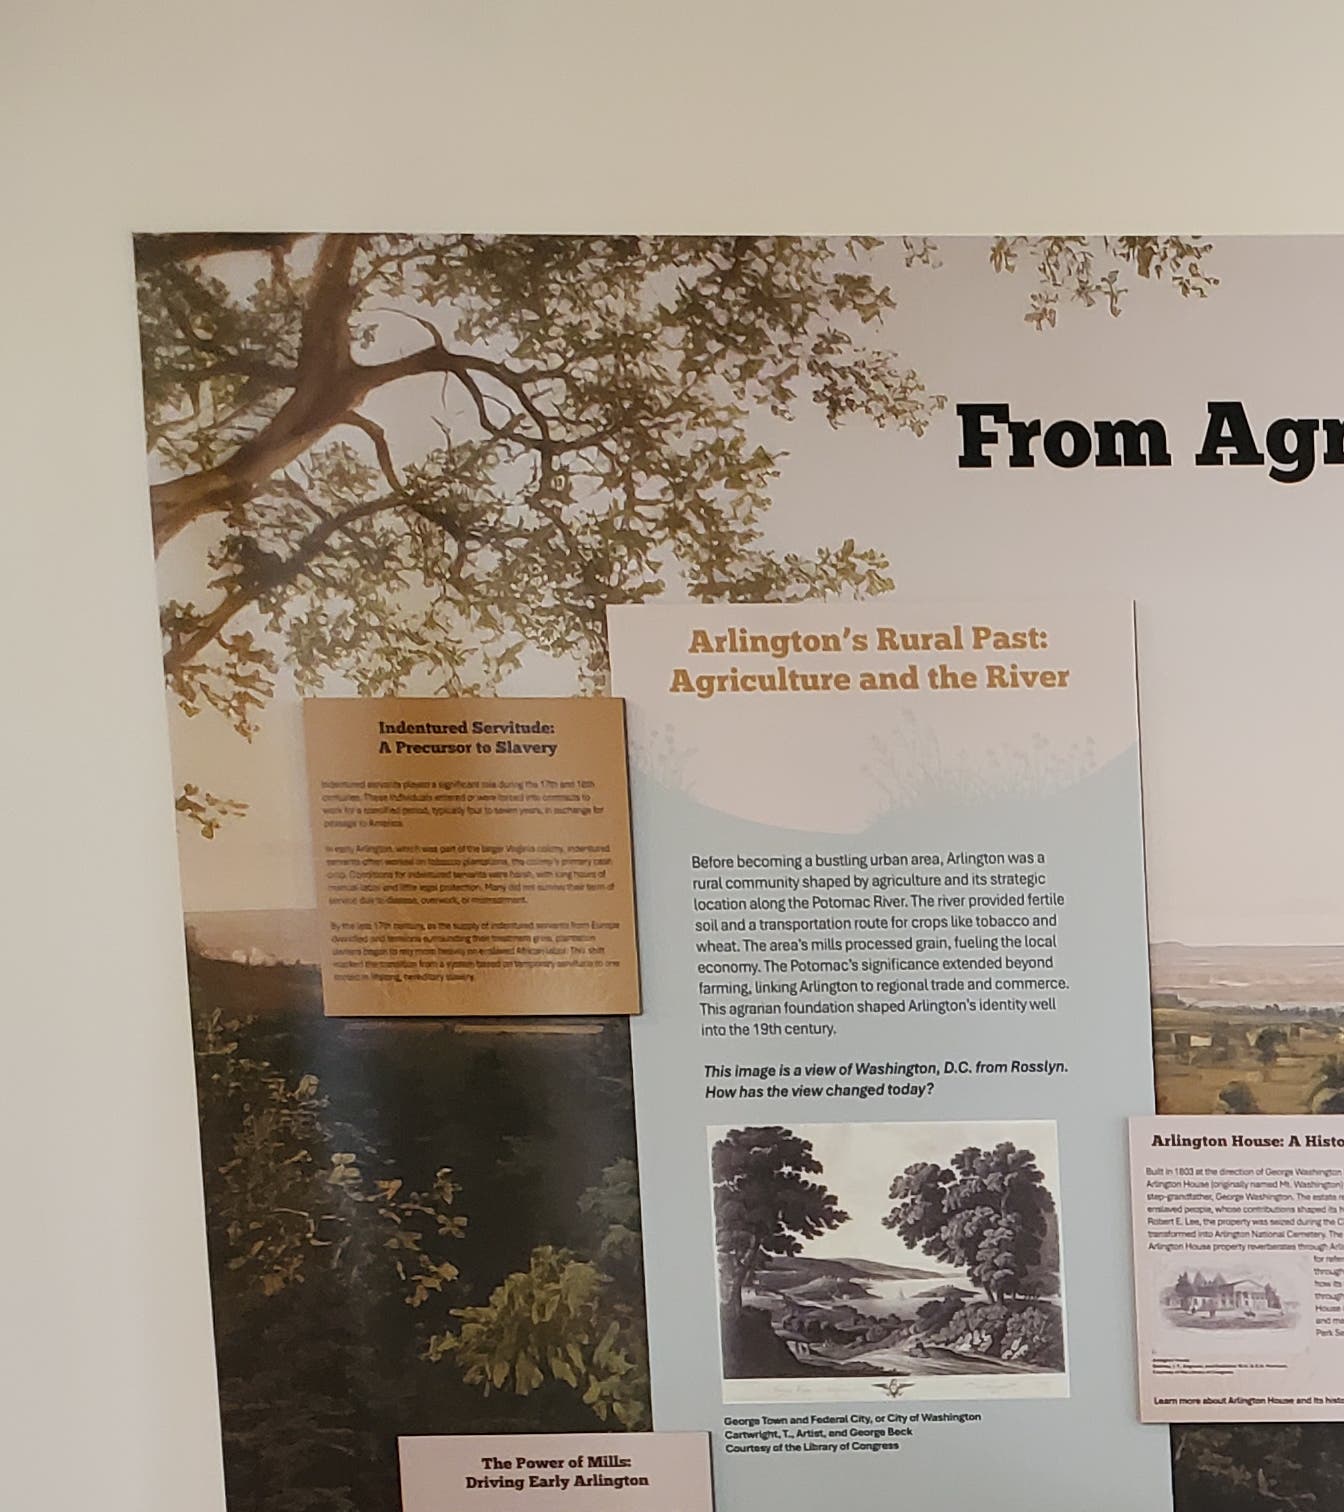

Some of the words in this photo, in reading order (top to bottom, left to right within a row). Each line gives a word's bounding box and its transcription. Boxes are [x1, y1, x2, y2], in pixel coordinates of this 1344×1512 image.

[956, 403, 1171, 467] From
[688, 628, 867, 658] Arlington's
[876, 625, 963, 650] Rural
[972, 626, 1047, 649] Past:
[669, 667, 850, 698] Agriculture
[859, 665, 919, 690] and
[927, 664, 976, 689] the
[985, 664, 1069, 688] River
[379, 720, 468, 734] Indentured
[472, 720, 554, 734] Servitude:
[379, 741, 391, 753] A
[395, 741, 471, 753] Precursor
[475, 742, 491, 753] to
[495, 740, 557, 756] Slavery
[704, 1065, 731, 1077] This
[735, 1065, 775, 1079] image
[779, 1064, 790, 1076] is
[793, 1066, 801, 1076] a
[804, 1064, 836, 1076] view
[839, 1063, 853, 1075] of
[855, 1062, 940, 1077] Washington,
[975, 1061, 1007, 1073] from
[1010, 1060, 1068, 1075] Rosslyn.
[1151, 1134, 1227, 1149] Arlington
[1231, 1135, 1283, 1147] House:
[1288, 1135, 1301, 1147] A
[724, 1417, 760, 1427] George
[761, 1416, 787, 1424] Town
[790, 1416, 809, 1424] and
[810, 1415, 848, 1423] Federal
[887, 1413, 907, 1424] City
[909, 1413, 919, 1422] of
[921, 1413, 981, 1423] Washington
[481, 1457, 512, 1469] The
[515, 1457, 564, 1468] Power
[568, 1455, 583, 1468] of
[587, 1455, 631, 1467] Mills:
[465, 1476, 524, 1490] Driving
[528, 1475, 569, 1490] Early
[573, 1474, 649, 1489] Arlington
